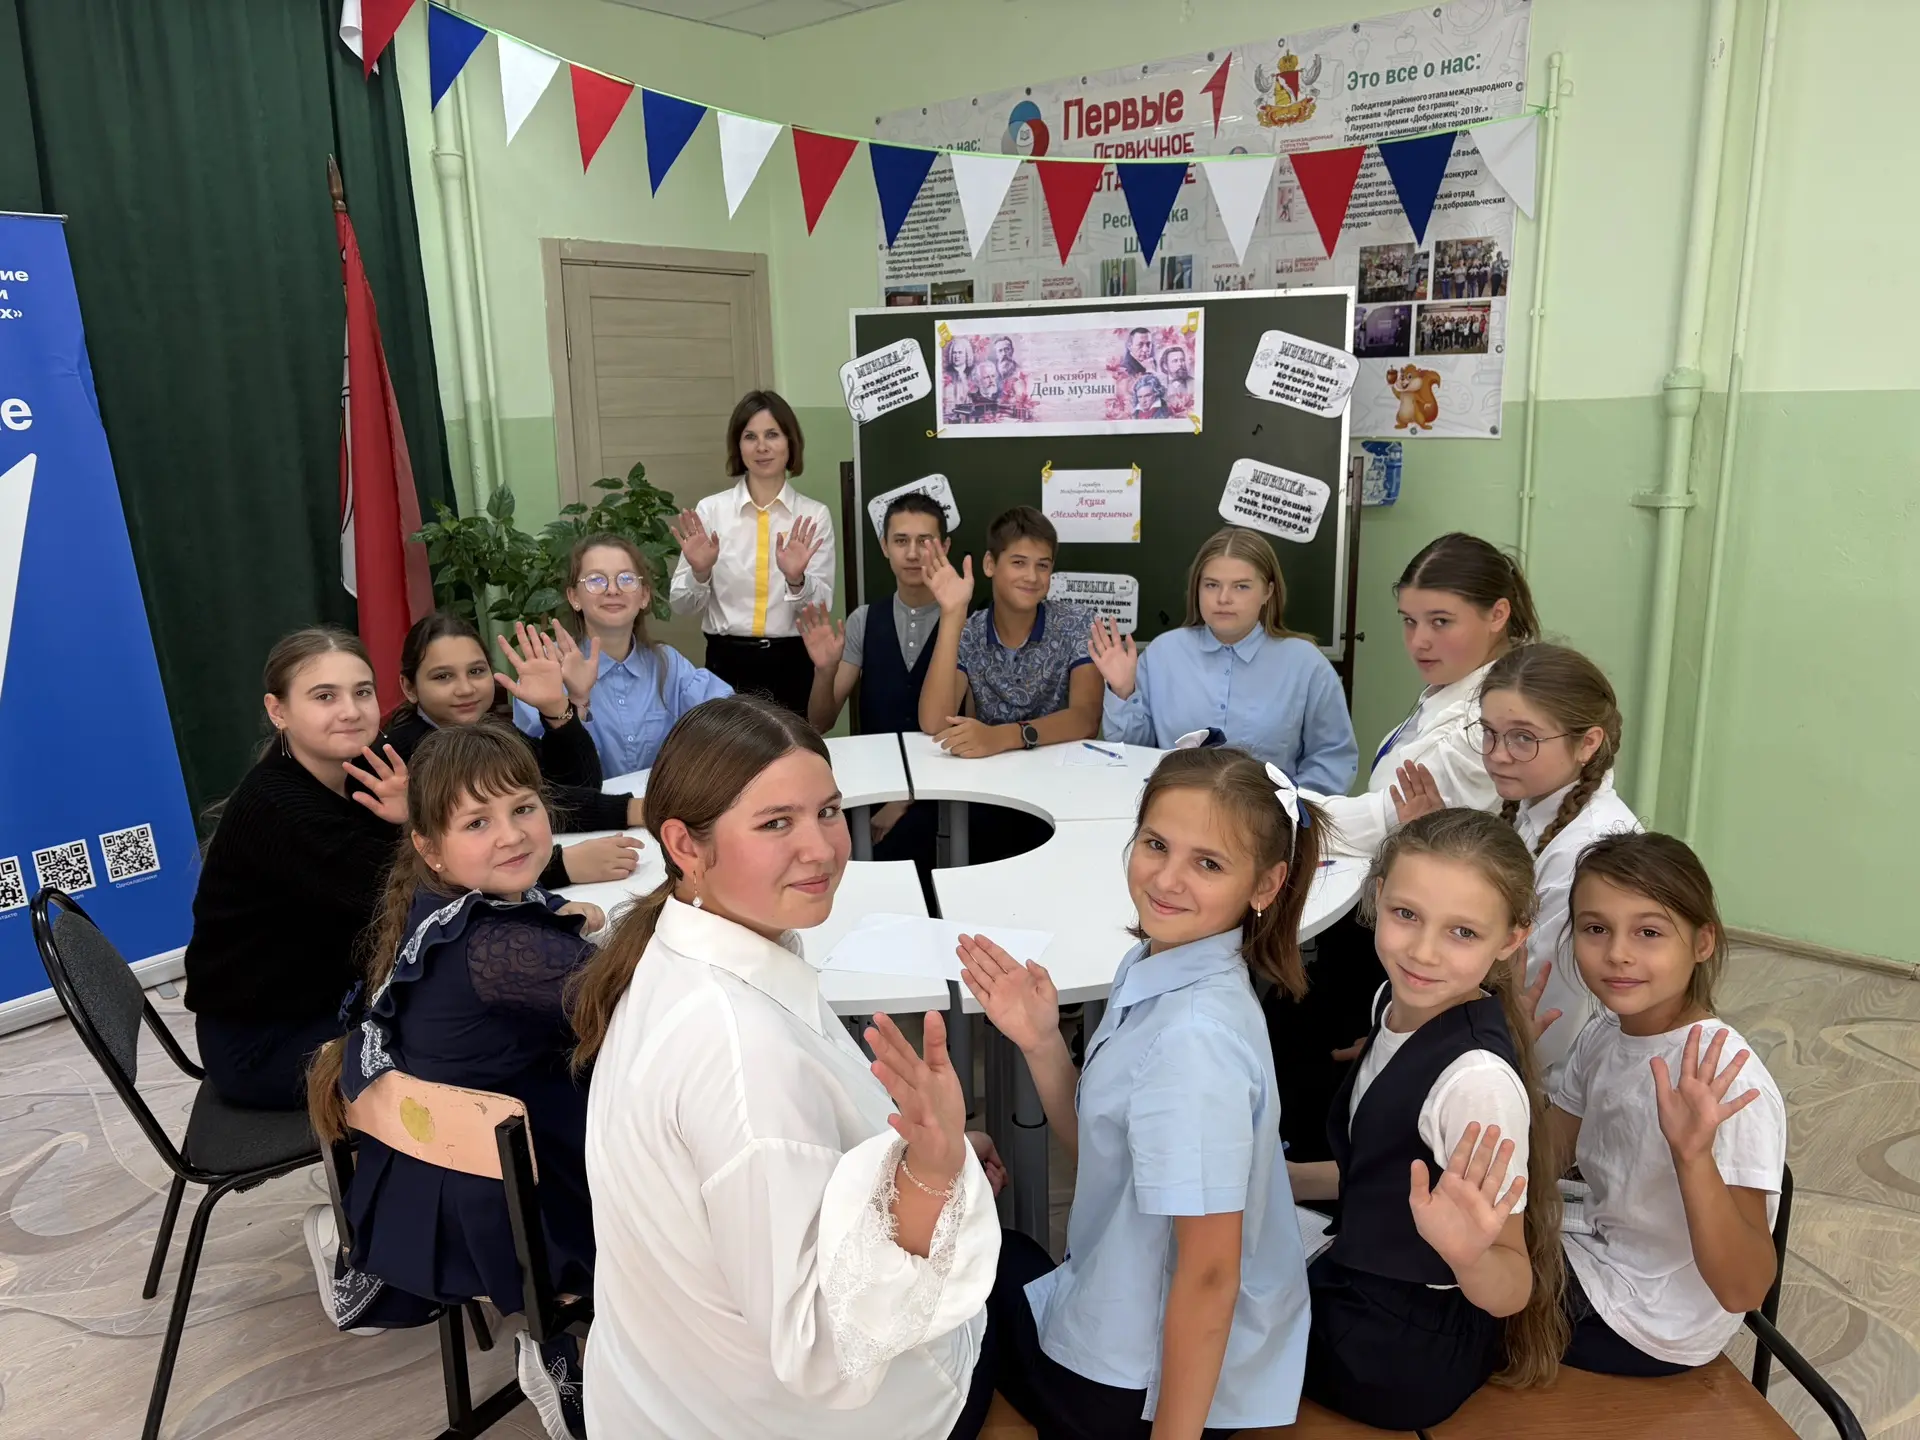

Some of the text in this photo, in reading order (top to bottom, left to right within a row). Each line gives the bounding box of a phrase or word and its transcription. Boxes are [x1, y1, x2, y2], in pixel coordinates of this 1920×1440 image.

[1347, 53, 1481, 91] Это все о нас:
[1351, 80, 1513, 112] Победители районного этапа международного
[1063, 89, 1184, 140] Первые
[1344, 101, 1459, 124] фестиваля «Детство без границ»
[1350, 121, 1383, 132] Лауреаты
[1384, 117, 1409, 128] премии
[1344, 131, 1383, 142] Победители
[1389, 125, 1428, 136] номинации
[1094, 131, 1195, 159] ПЕРВИЧНОЕ
[1445, 169, 1478, 179] конкурса
[1453, 190, 1475, 199] отряд
[1442, 197, 1506, 211] добровольческих
[1053, 369, 1097, 383] октября
[1274, 361, 1289, 370] ЭТО
[1317, 374, 1339, 387] ЧЕРЕЗ
[1277, 371, 1330, 394] КОТОРУЮ МЫ
[860, 383, 890, 400] КОТОРОЕ
[890, 380, 899, 389] НЕ
[862, 379, 875, 391] ЭТО
[1031, 382, 1116, 399] День музыки
[1272, 380, 1328, 403] МОЖЕМ ВОЙТИ
[877, 387, 902, 403] ГРАНИЦ
[1076, 497, 1106, 508] Акция
[1244, 487, 1260, 498] ЭТО
[1262, 491, 1281, 504] НАШ
[1050, 509, 1133, 521] «Мелодия перемены»
[1234, 504, 1310, 534] ТРЕБУЕТ ПЕРЕВОДА
[1262, 503, 1301, 521] КОТОРЫЙ
[1302, 515, 1313, 524] НЕ
[1065, 579, 1116, 594] МУЗЫКА
